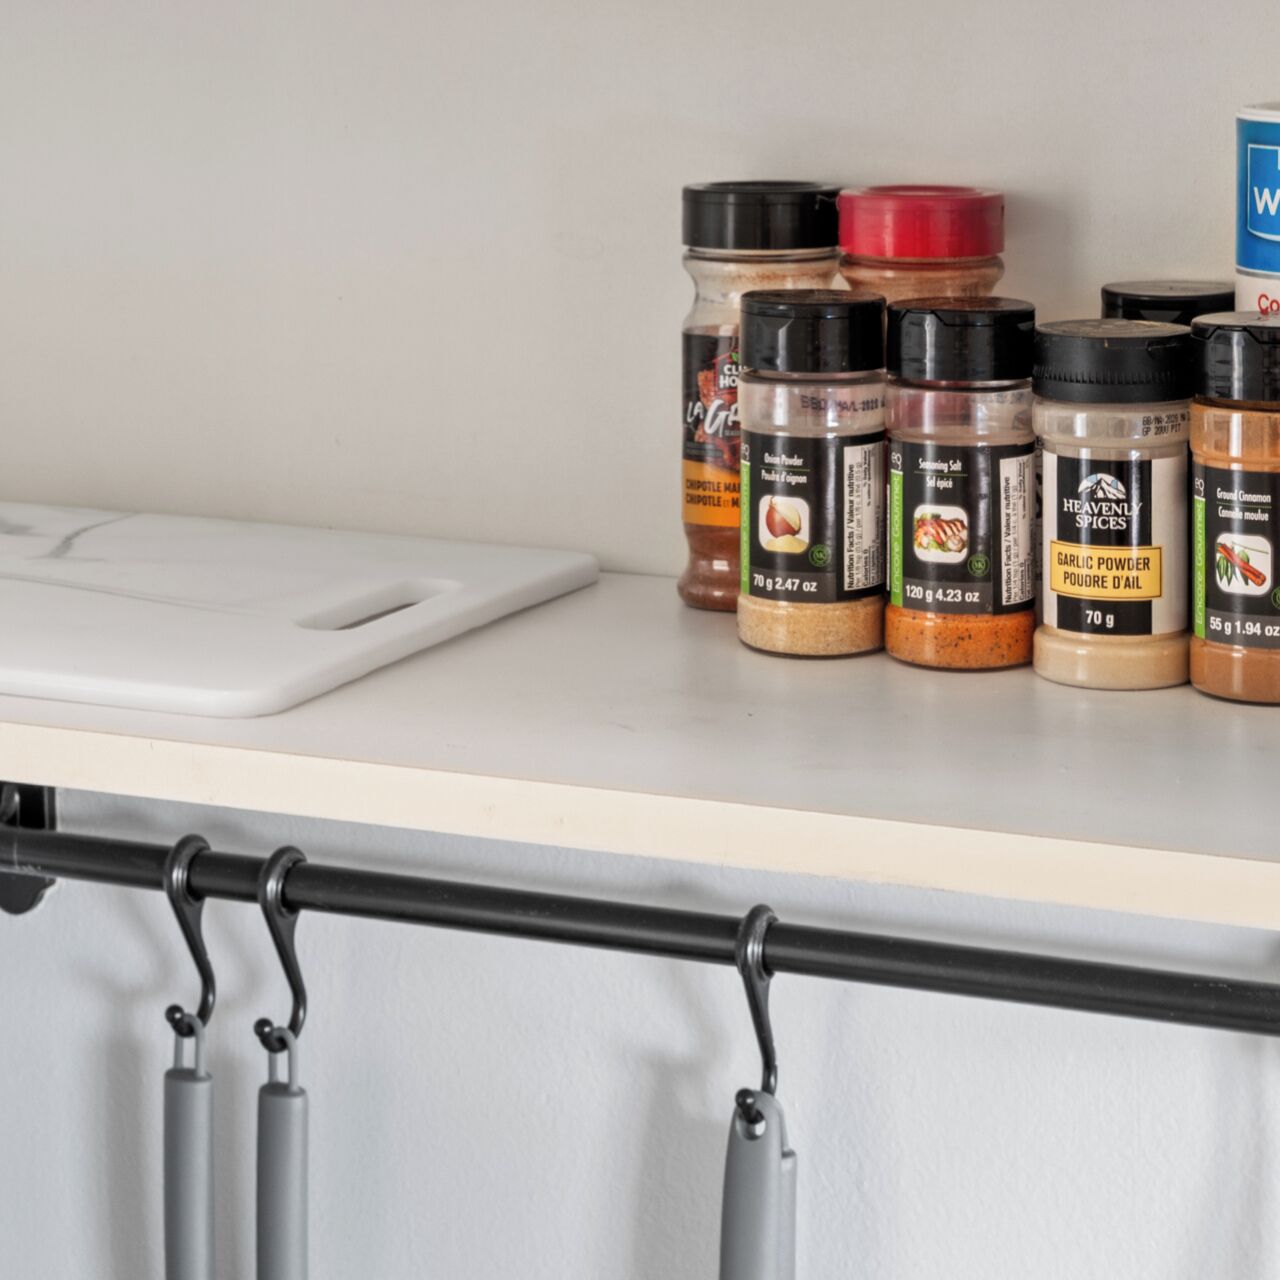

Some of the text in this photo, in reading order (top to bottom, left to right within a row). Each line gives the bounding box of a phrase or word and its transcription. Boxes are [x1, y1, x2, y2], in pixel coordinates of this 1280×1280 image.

[764, 452, 803, 466] Onion Powder
[919, 458, 962, 473] Seasoning Salt
[686, 478, 722, 493] CHIPOTLE
[926, 477, 953, 490] Sel épicé
[686, 493, 722, 507] CHIPOTLE
[1217, 488, 1271, 502] Ground Cinnamon
[1063, 498, 1142, 516] HEAVENLY
[1218, 506, 1268, 521] Cannelle moulue
[1076, 515, 1127, 530] SPICES
[1057, 552, 1150, 571] GARLIC POWDER
[753, 574, 817, 591] 70 g 2.47 oz
[1064, 572, 1142, 590] POUDRE D'AIL
[905, 584, 980, 603] 120 g 4.23 oz
[1086, 610, 1114, 628] 70 g
[1210, 617, 1280, 636] 55 g 1.94 oz
